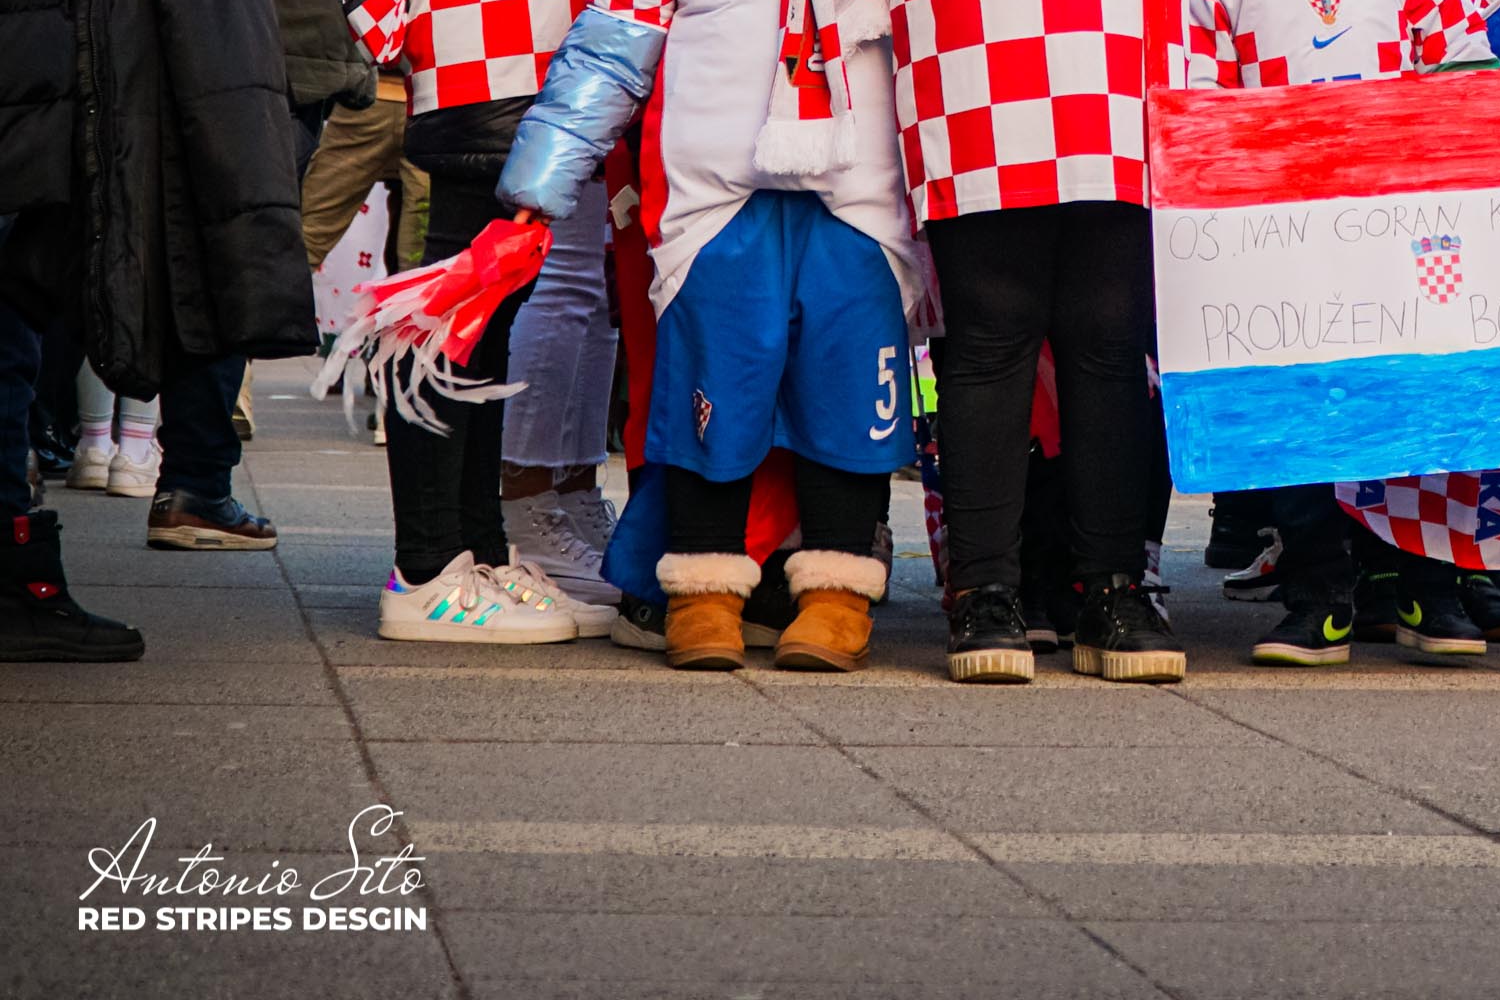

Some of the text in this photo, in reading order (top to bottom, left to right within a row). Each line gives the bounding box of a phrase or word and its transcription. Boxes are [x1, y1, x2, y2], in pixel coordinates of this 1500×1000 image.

[1333, 201, 1463, 243] GORAN
[1201, 291, 1419, 363] PRODUŽENI
[875, 345, 897, 421] 5
